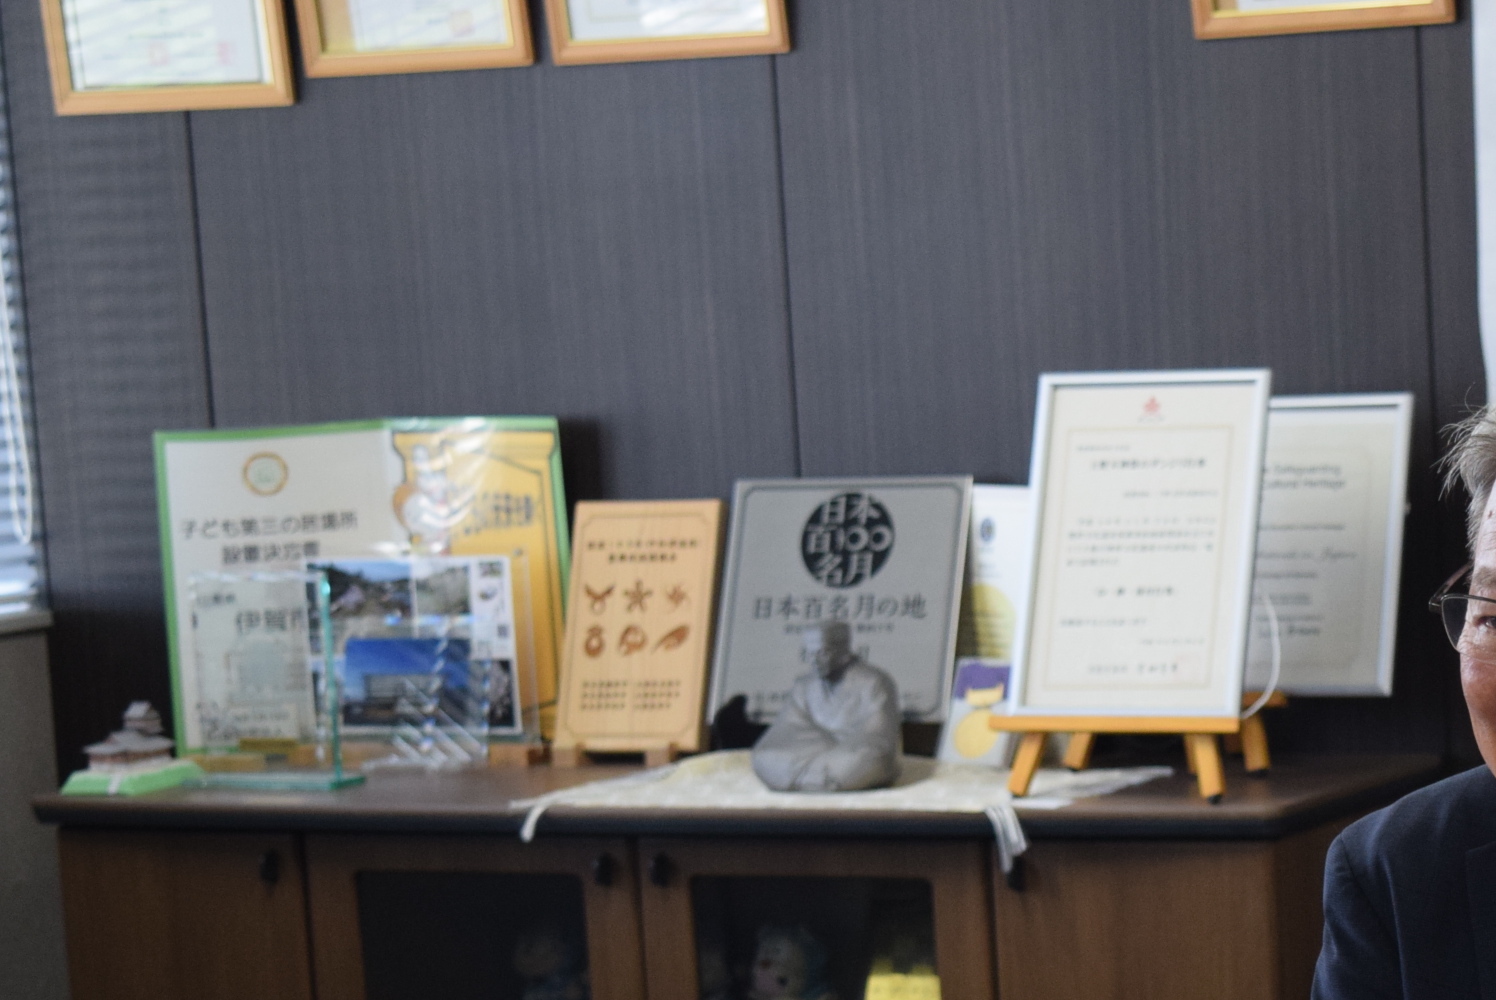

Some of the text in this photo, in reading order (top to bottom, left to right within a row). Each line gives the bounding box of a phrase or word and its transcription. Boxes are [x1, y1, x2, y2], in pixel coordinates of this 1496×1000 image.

[182, 511, 358, 539] 子ども第三の居場所
[754, 592, 928, 620] 日本百名月の地
